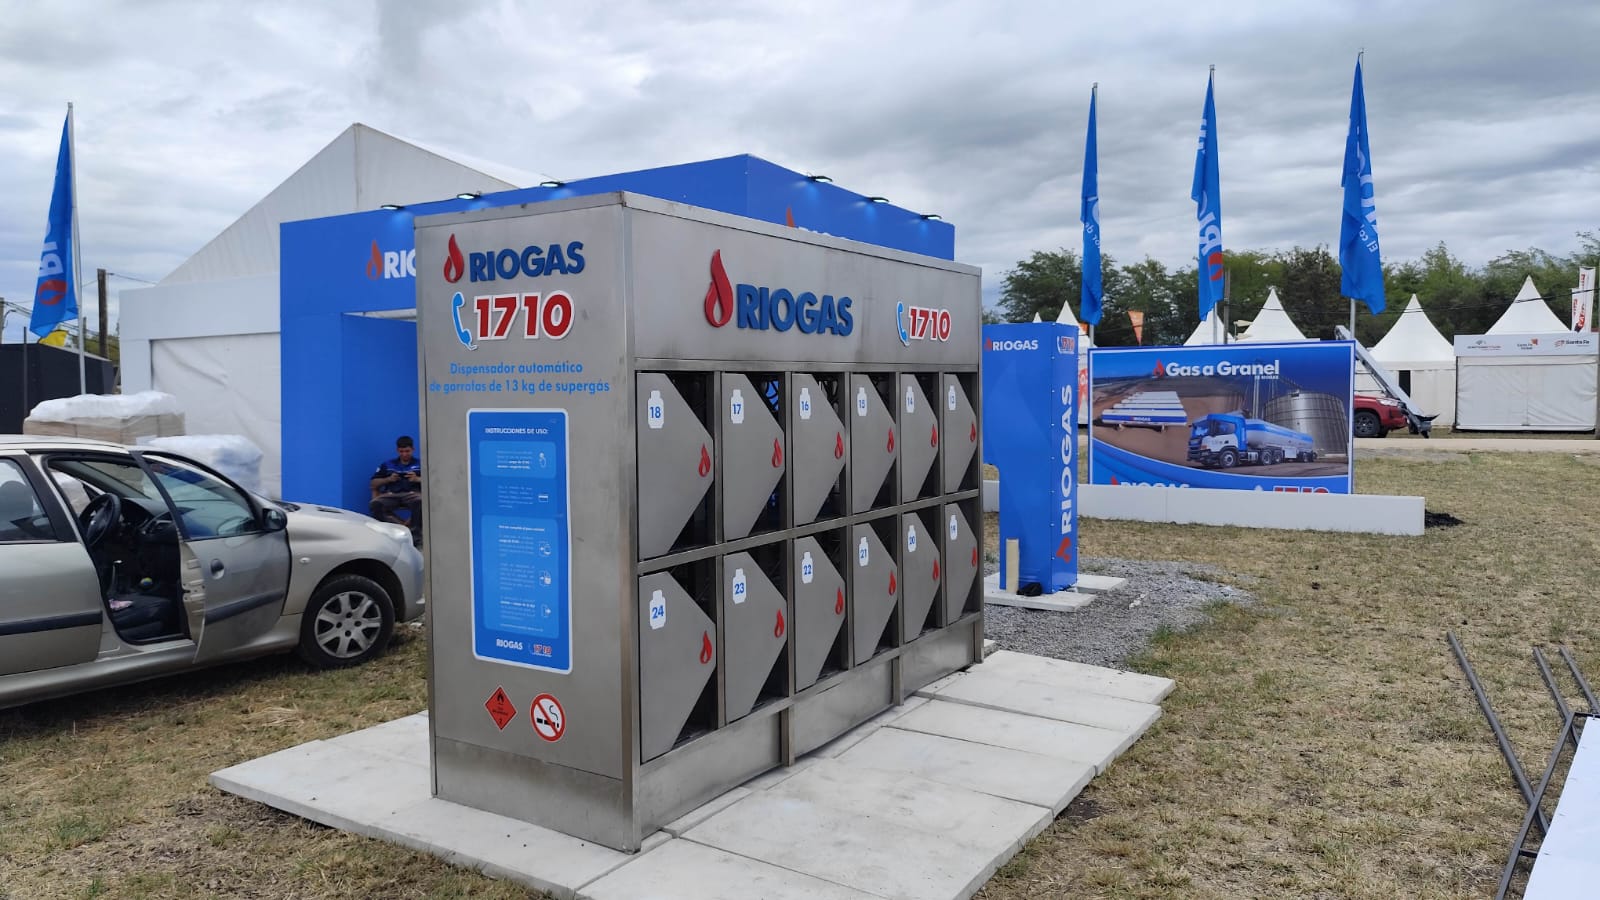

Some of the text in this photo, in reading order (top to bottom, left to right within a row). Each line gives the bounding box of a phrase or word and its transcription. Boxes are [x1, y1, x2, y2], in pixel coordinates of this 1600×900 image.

[469, 241, 585, 283] RIOGAS
[474, 290, 575, 341] 1710
[736, 283, 854, 337] RIOGAS
[908, 305, 951, 342] 1710
[992, 339, 1038, 351] RIOGAS
[450, 361, 583, 376] Dispensador automático
[1165, 359, 1280, 377] Gas a Granel
[429, 380, 441, 392] de
[489, 380, 502, 392] de
[506, 379, 519, 392] 13
[521, 379, 535, 394] kg
[538, 379, 552, 392] de
[555, 378, 610, 394] supergás
[649, 406, 661, 419] 18
[732, 403, 742, 415] 17
[801, 401, 809, 412] 16
[1061, 384, 1072, 535] RIOGAS
[860, 548, 867, 559] 21
[803, 564, 812, 575] 22
[734, 582, 744, 595] 23
[652, 605, 664, 619] 24
